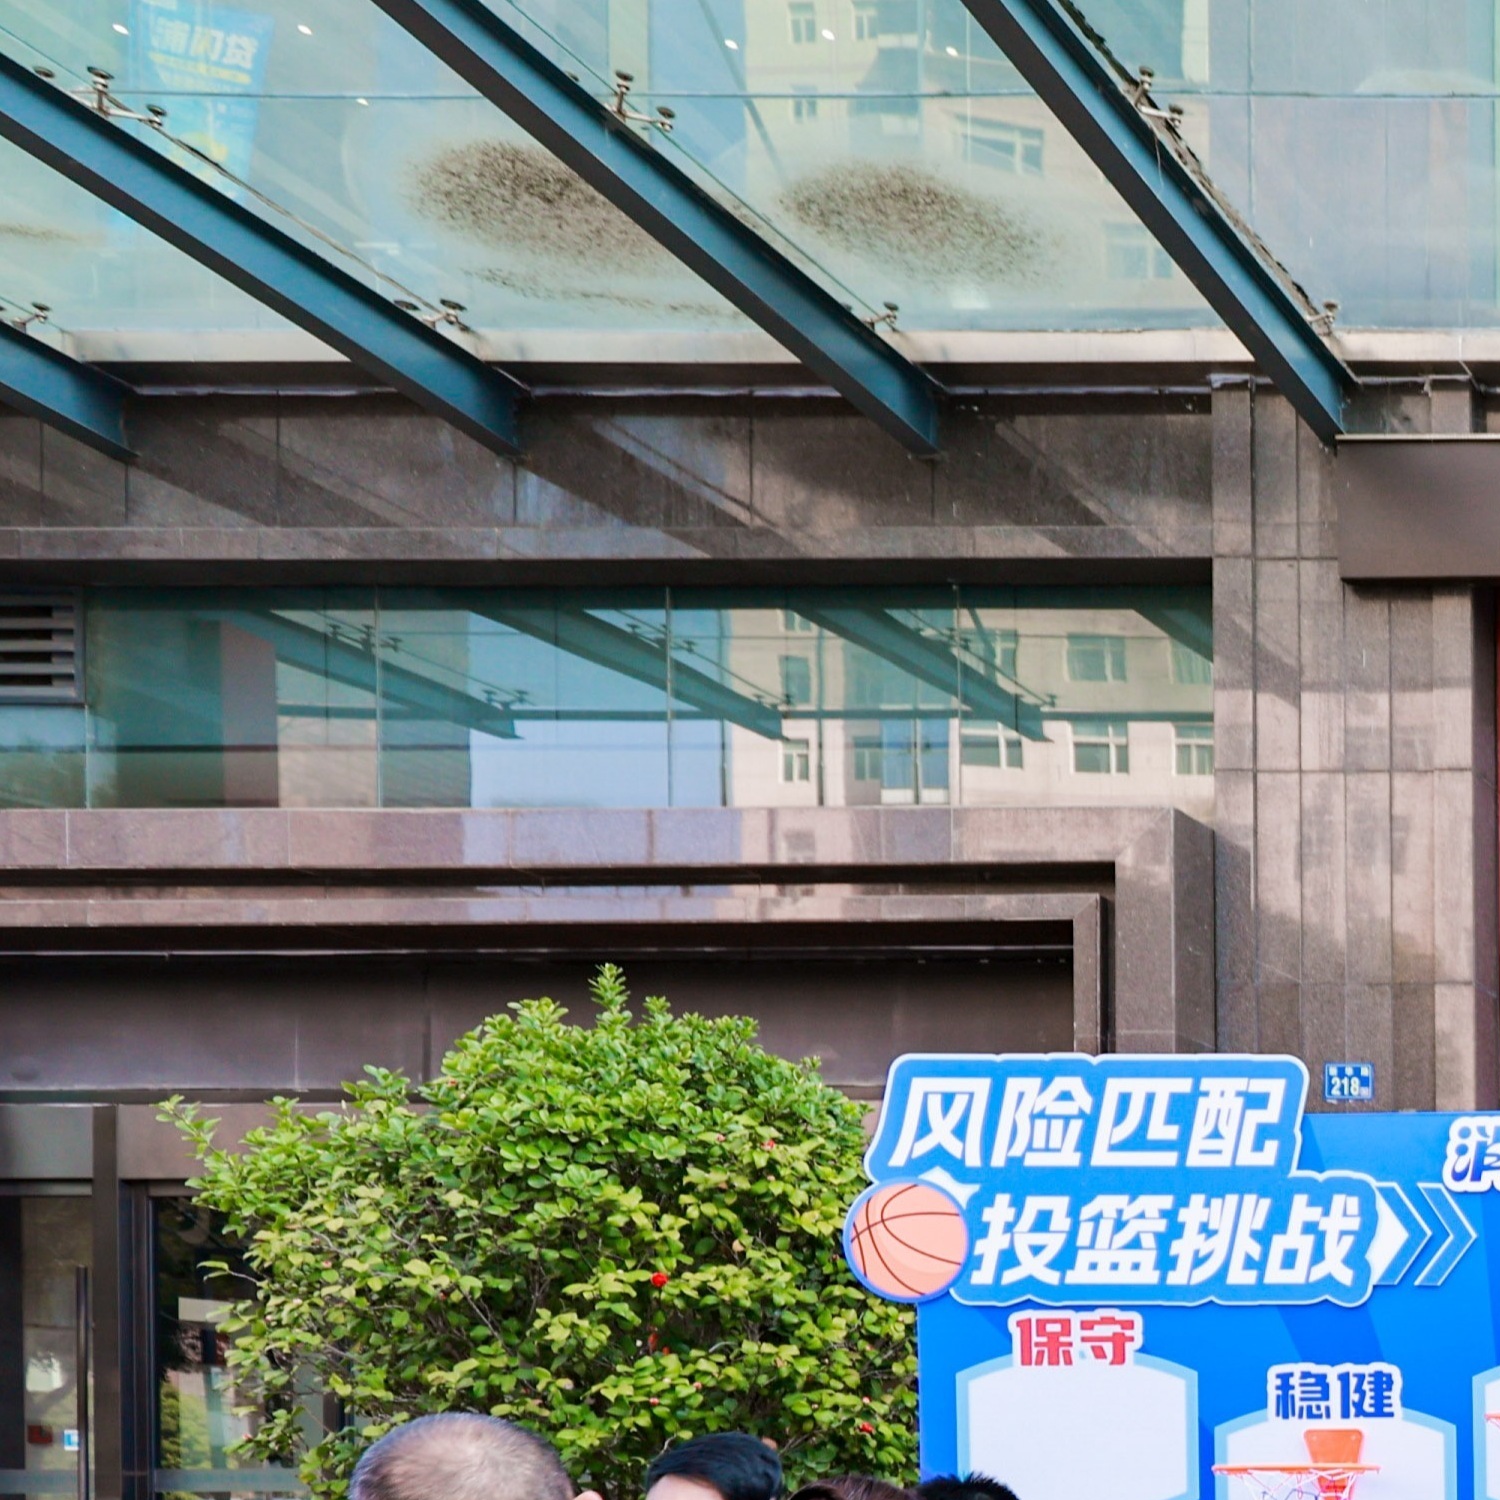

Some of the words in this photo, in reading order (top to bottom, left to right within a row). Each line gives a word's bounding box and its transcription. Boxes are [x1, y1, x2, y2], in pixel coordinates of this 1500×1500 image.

[889, 1076, 1287, 1169] 风险匹配
[969, 1192, 1362, 1288] 投篮挑战
[1015, 1314, 1138, 1369] 保守
[1274, 1369, 1397, 1420] 稳健
